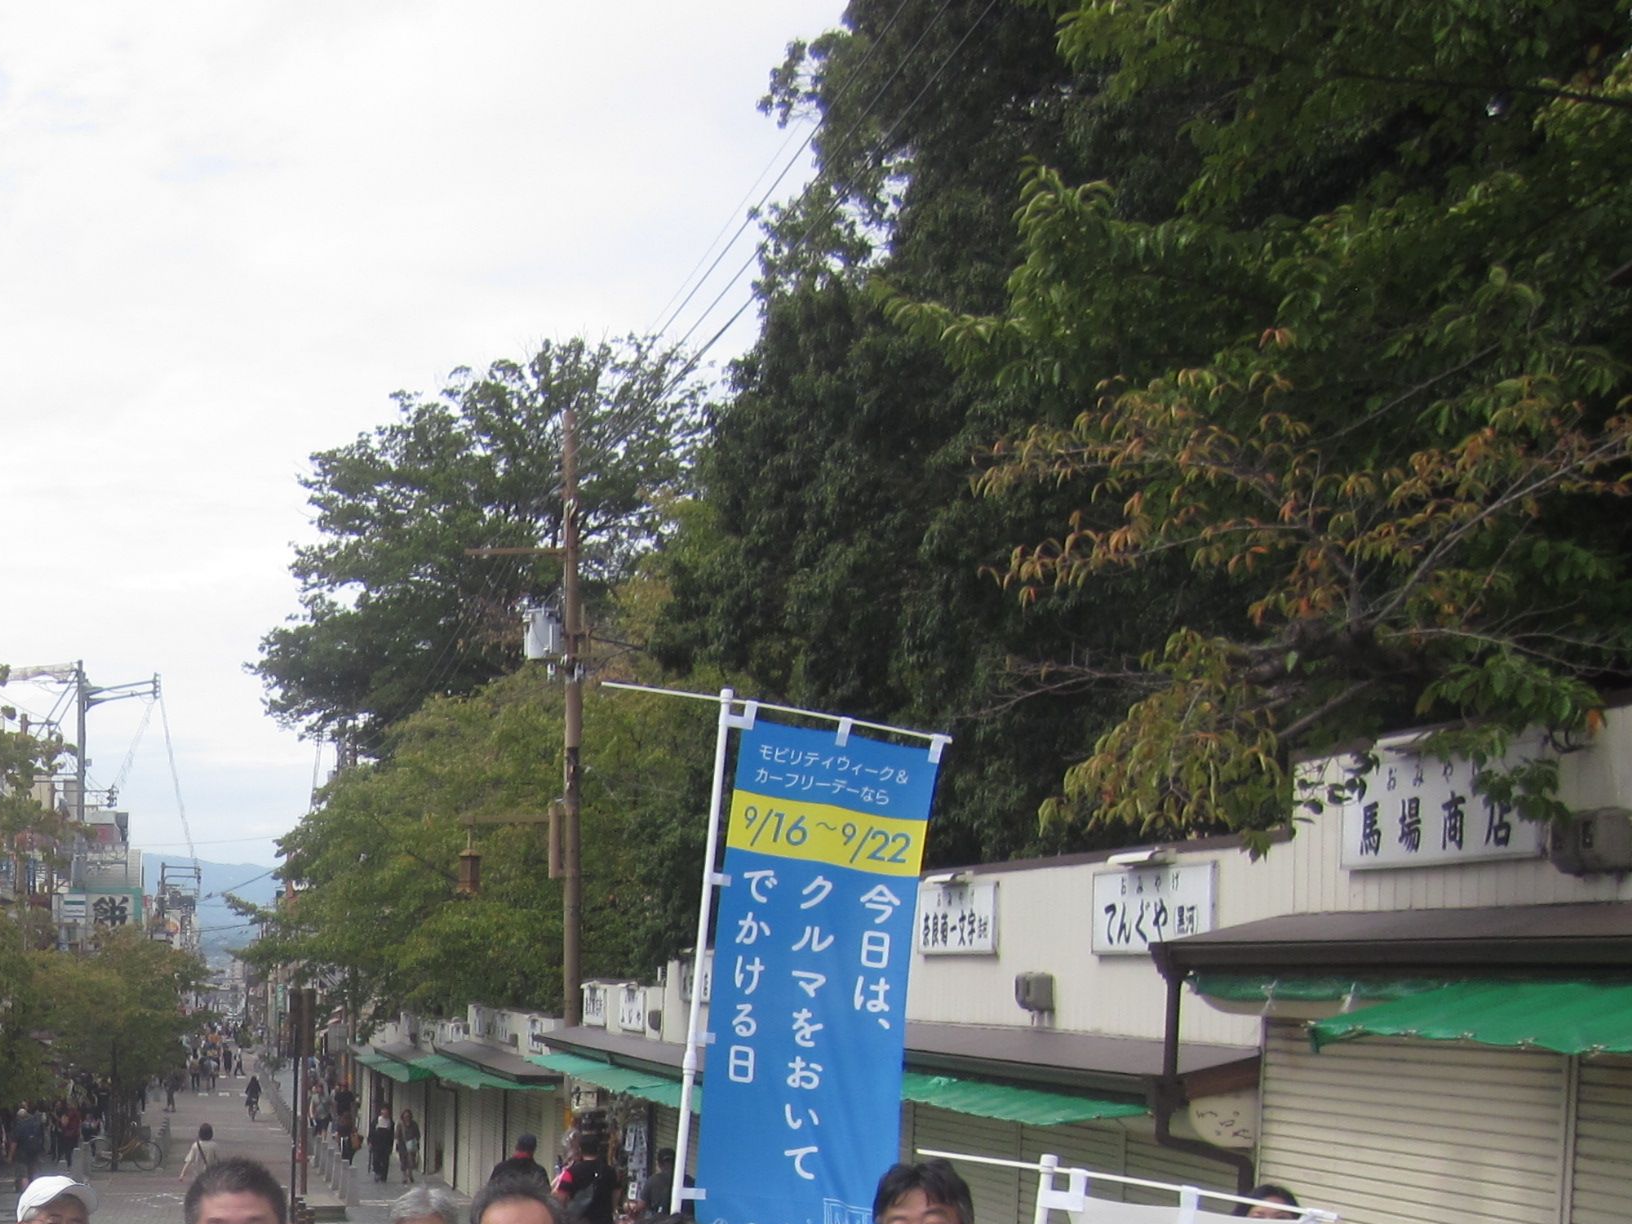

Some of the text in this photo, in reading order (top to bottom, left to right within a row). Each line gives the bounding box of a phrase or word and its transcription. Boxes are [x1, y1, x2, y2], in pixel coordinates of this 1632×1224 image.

[754, 767, 891, 806] カーフリーデーなら
[759, 743, 909, 786] モビリティウィーク&
[1386, 760, 1478, 792] おみや
[1359, 790, 1513, 857] 馬場商店
[1104, 897, 1168, 945] てんぐや
[728, 868, 779, 1084] でかける日
[853, 883, 901, 1030] 今日は、
[784, 874, 835, 1181] クルマをおいて
